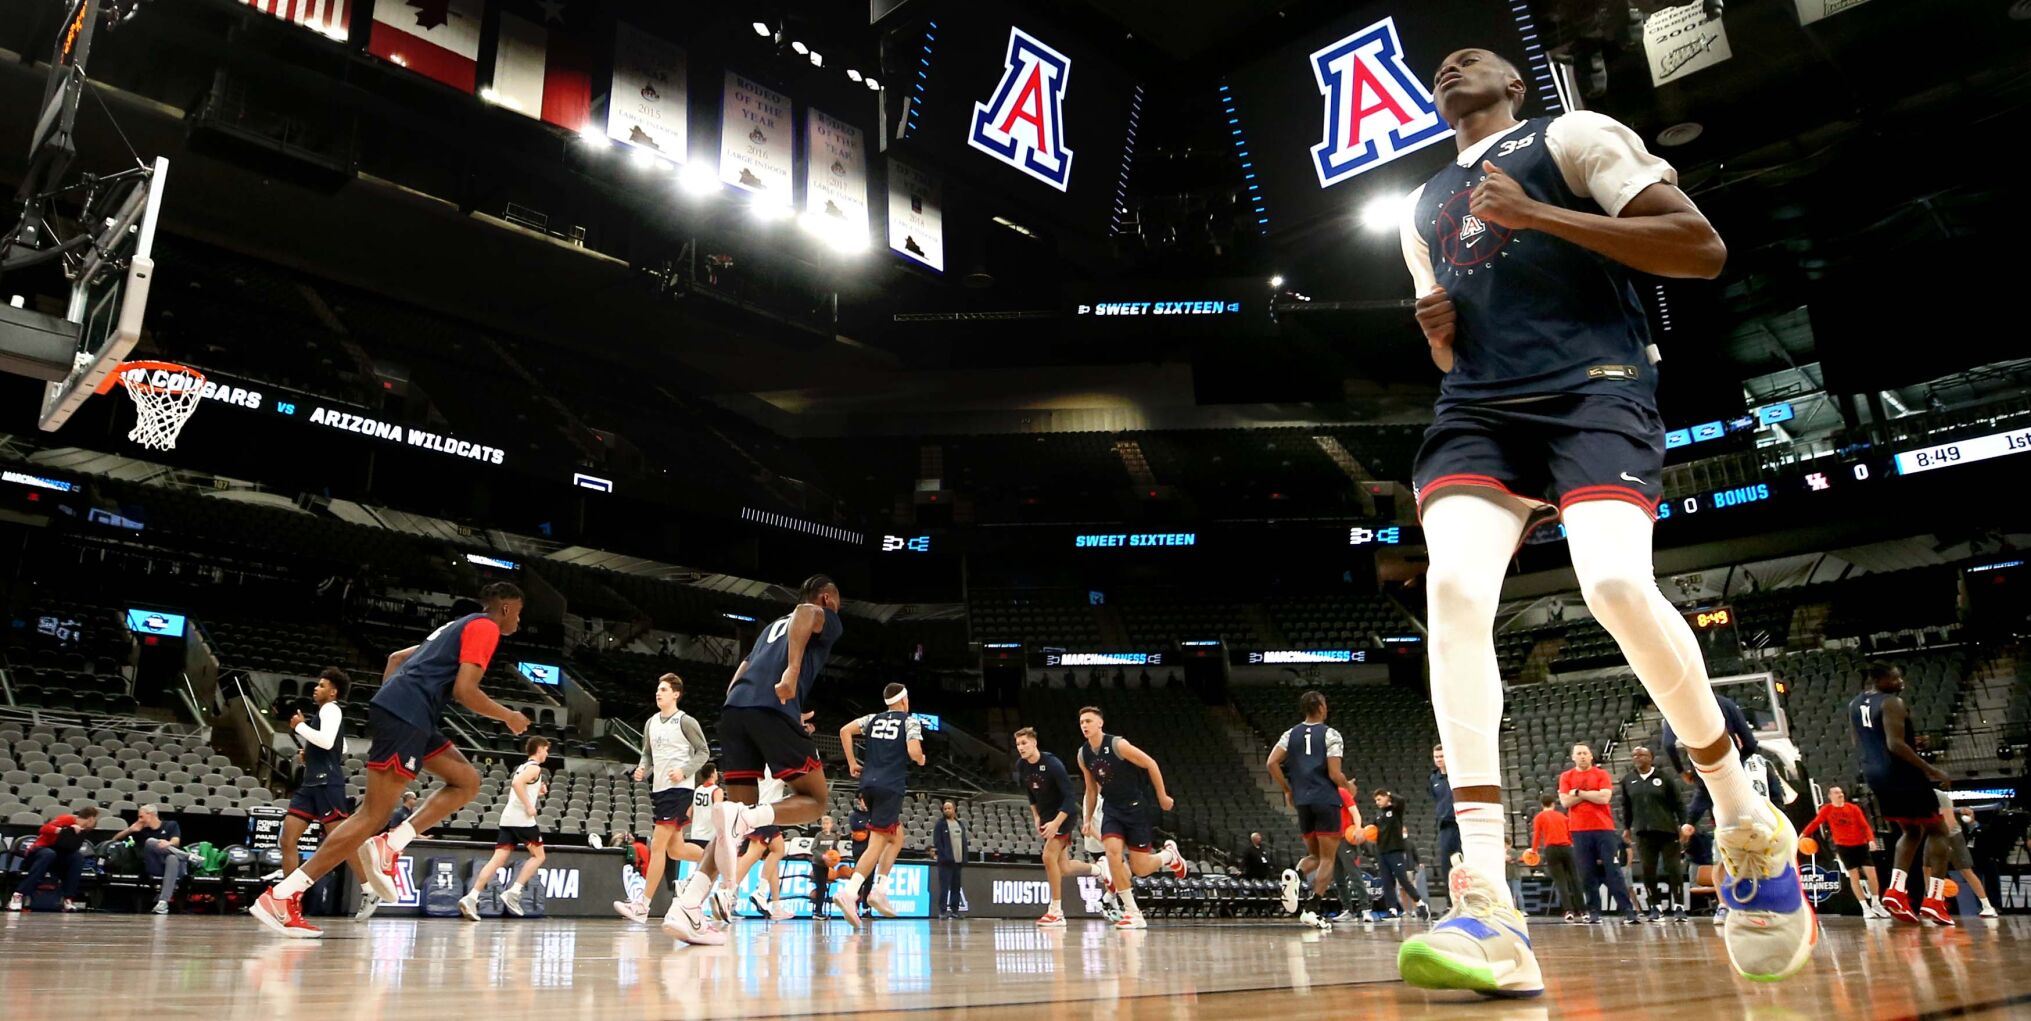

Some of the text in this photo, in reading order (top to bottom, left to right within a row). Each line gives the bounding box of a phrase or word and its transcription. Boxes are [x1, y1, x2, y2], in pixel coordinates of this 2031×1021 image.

[638, 103, 662, 120] 2015
[968, 26, 1073, 192] A
[1498, 132, 1536, 157] 35
[1095, 301, 1224, 315] SWEET SIXTEEN
[151, 370, 262, 409] COUGARS
[276, 401, 296, 415] VS
[309, 407, 402, 441] ARIZONA
[407, 428, 505, 465] WILDCATS
[1916, 446, 1961, 467] 8:49
[1853, 463, 1869, 480] 0
[1684, 497, 1698, 514] 0
[1713, 483, 1769, 509] BONUS
[1076, 533, 1195, 547] SWEET SIXTEEN
[1697, 610, 1728, 628] 8:49
[870, 718, 902, 740] 25
[1304, 733, 1312, 756] 1
[695, 792, 710, 807] 50
[993, 880, 1051, 904] HOUSTO
